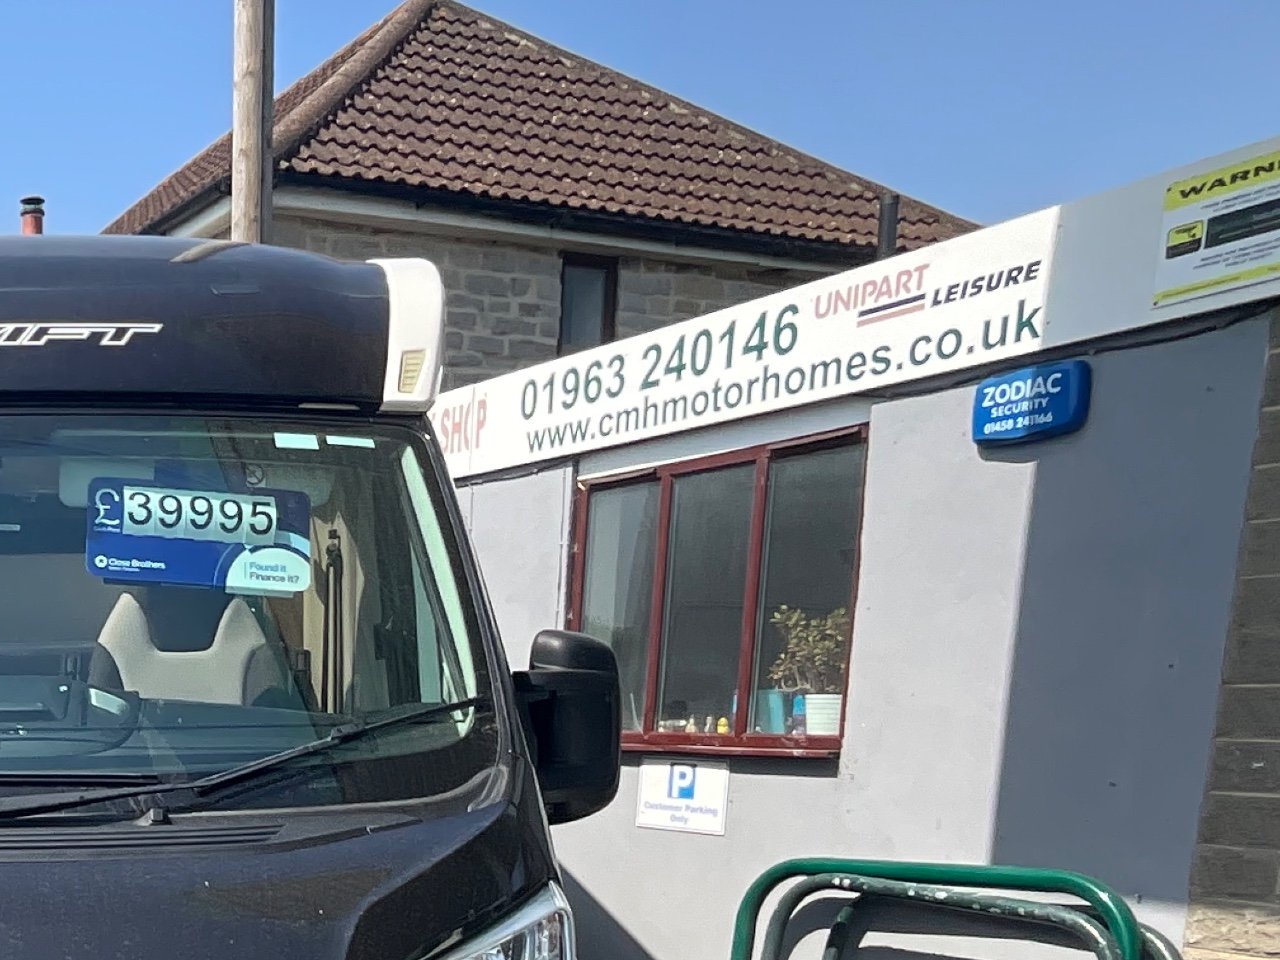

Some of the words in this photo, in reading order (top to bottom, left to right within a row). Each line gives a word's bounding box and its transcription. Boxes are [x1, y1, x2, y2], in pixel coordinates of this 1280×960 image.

[813, 264, 930, 319] UNIPART
[930, 260, 1042, 308] LEISURE
[521, 354, 626, 420] 01963
[639, 304, 800, 391] 240146
[526, 299, 1042, 453] www.cmhmotorhomes.co.uk
[982, 373, 1062, 407] ZODIAC
[990, 397, 1050, 418] SECURITY
[249, 562, 279, 572] Found
[249, 572, 286, 582] Finance
